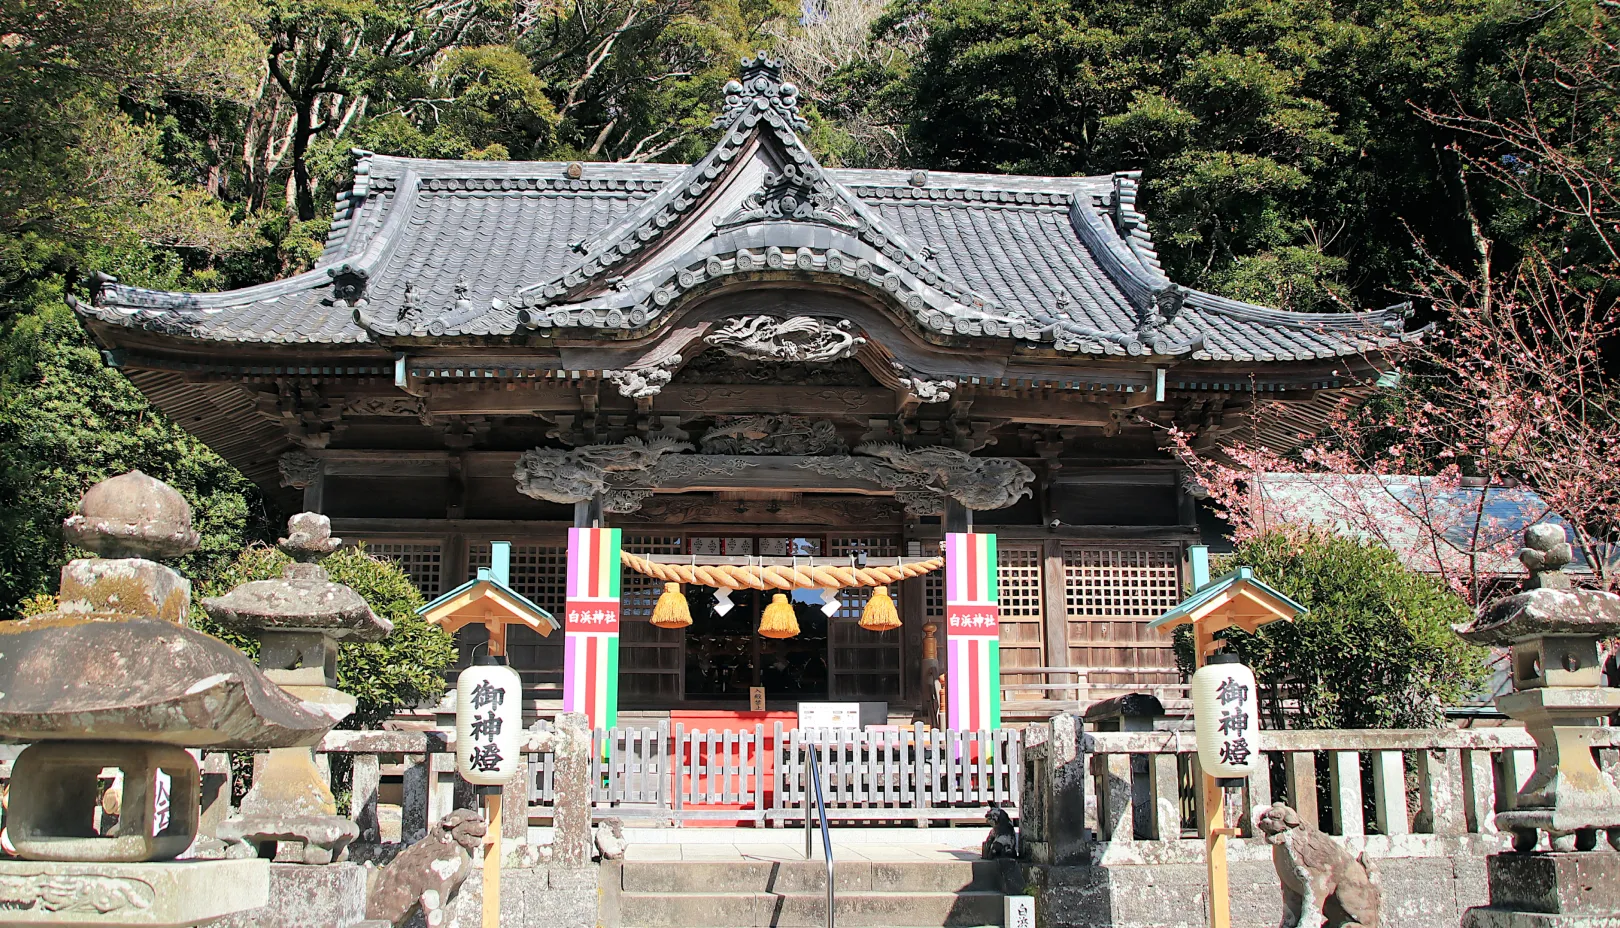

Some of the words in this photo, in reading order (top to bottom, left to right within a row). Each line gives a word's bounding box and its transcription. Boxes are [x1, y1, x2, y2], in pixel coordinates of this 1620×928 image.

[568, 609, 617, 625] 白浜神社
[949, 613, 997, 628] 白浜神社
[469, 679, 506, 772] 御神燈
[1215, 676, 1252, 766] 御神燈
